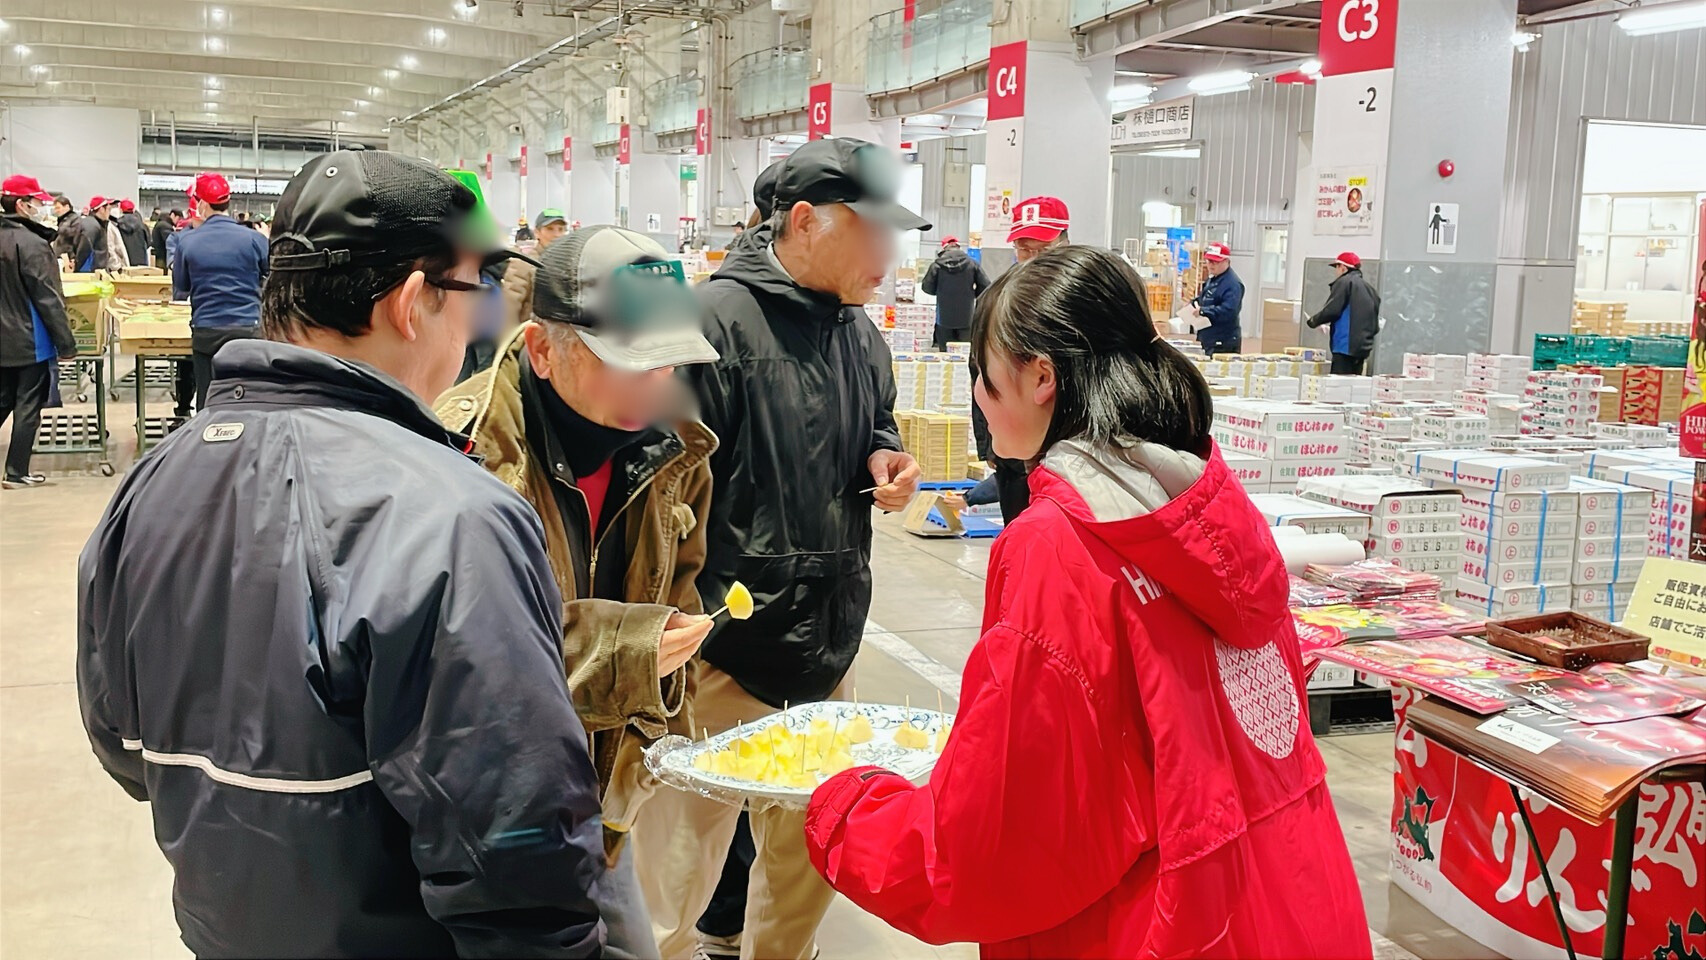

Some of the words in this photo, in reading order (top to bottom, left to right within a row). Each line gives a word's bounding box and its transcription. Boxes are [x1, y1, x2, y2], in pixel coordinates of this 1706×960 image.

[1338, 0, 1379, 42] C3
[996, 66, 1017, 98] C4
[1358, 87, 1377, 112] -2
[814, 102, 827, 126] C5
[1006, 129, 1017, 147] -2
[1295, 421, 1320, 432] ほし柿
[1232, 434, 1256, 450] ほし柿
[1301, 443, 1325, 455] ほし柿
[1298, 466, 1323, 477] ほし柿
[1654, 593, 1706, 613] ご自由にお
